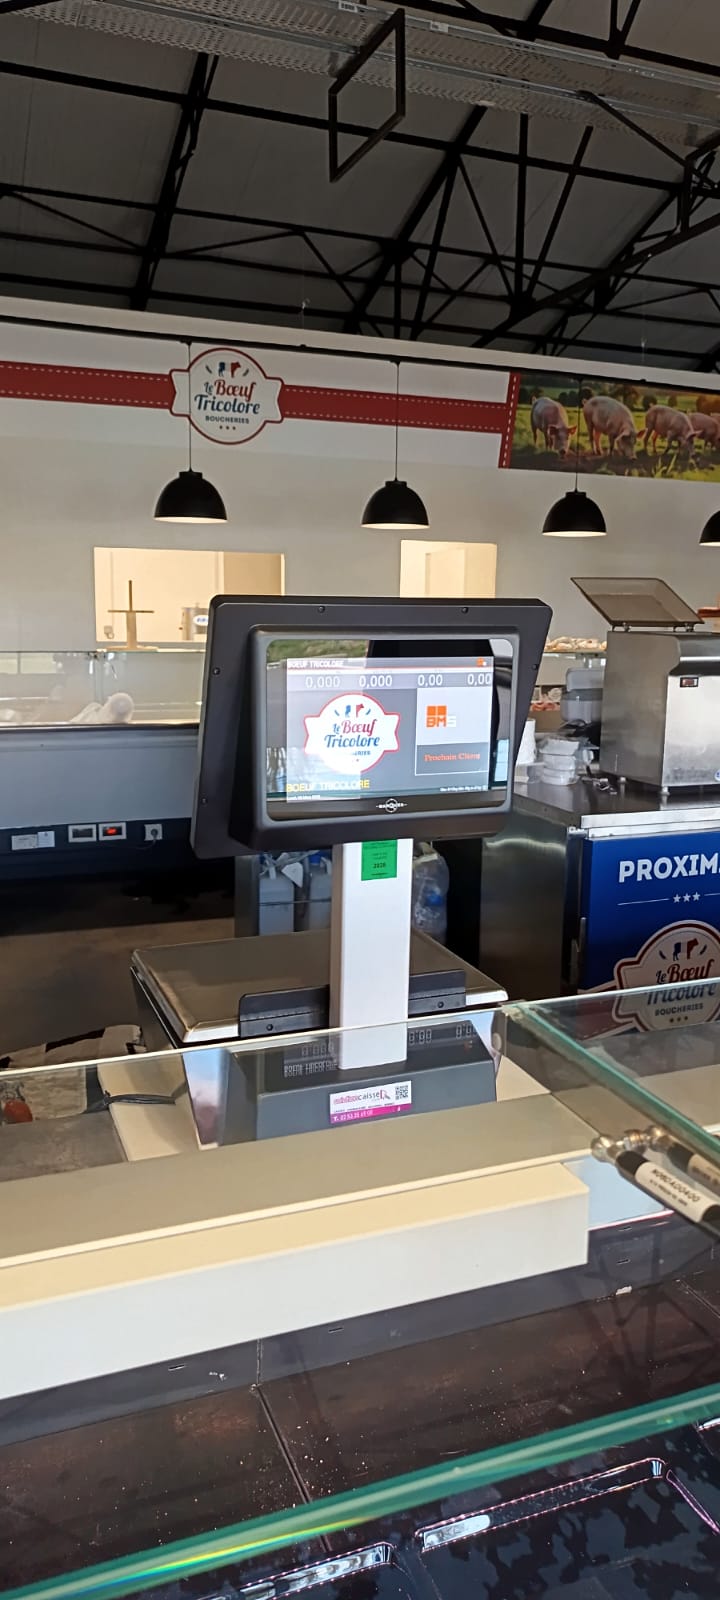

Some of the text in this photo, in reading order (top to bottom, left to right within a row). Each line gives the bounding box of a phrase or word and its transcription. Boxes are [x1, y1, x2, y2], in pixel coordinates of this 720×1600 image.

[203, 379, 257, 402] Le Bœuf
[194, 394, 261, 414] Tricolore
[205, 415, 250, 424] BOUCHERIES
[305, 673, 492, 689] 0,000 0,000 0,00 0,00
[332, 719, 378, 736] Le Bœuf
[324, 734, 380, 748] Tricolore
[618, 852, 720, 883] PROXIM
[656, 970, 667, 984] Le
[655, 1002, 704, 1016] BOUCHERIES
